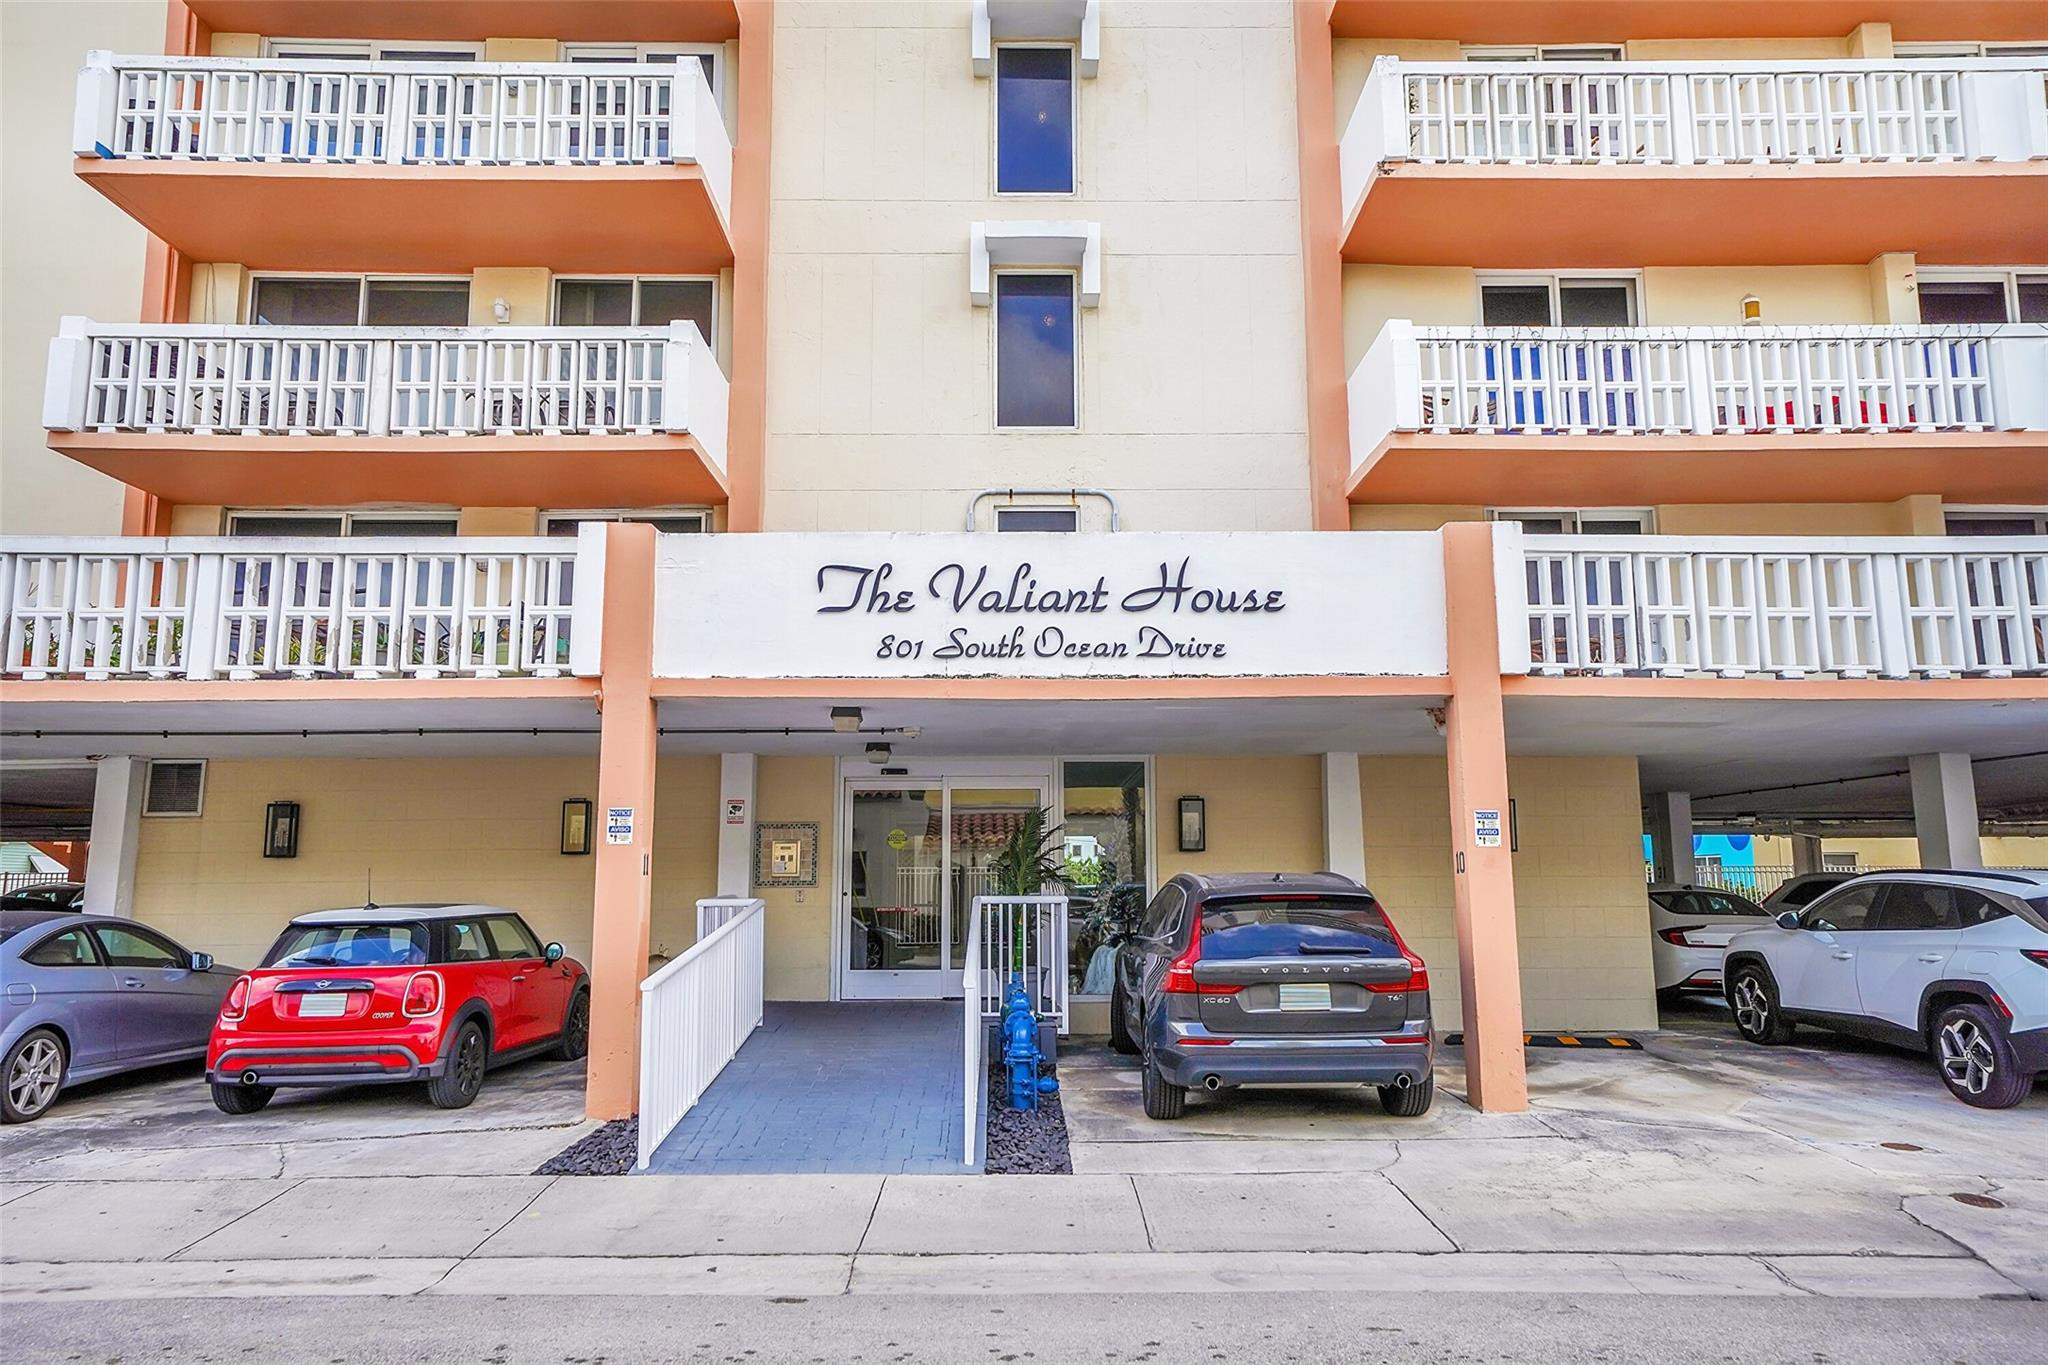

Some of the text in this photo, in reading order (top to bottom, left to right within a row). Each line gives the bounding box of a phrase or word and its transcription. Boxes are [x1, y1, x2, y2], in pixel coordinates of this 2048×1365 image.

[816, 555, 1287, 614] The Valiant House
[876, 625, 1227, 660] 801 South Ocean Drive
[1456, 851, 1465, 874] 10
[1260, 966, 1350, 974] VOLVO
[371, 1011, 395, 1019] COOPER
